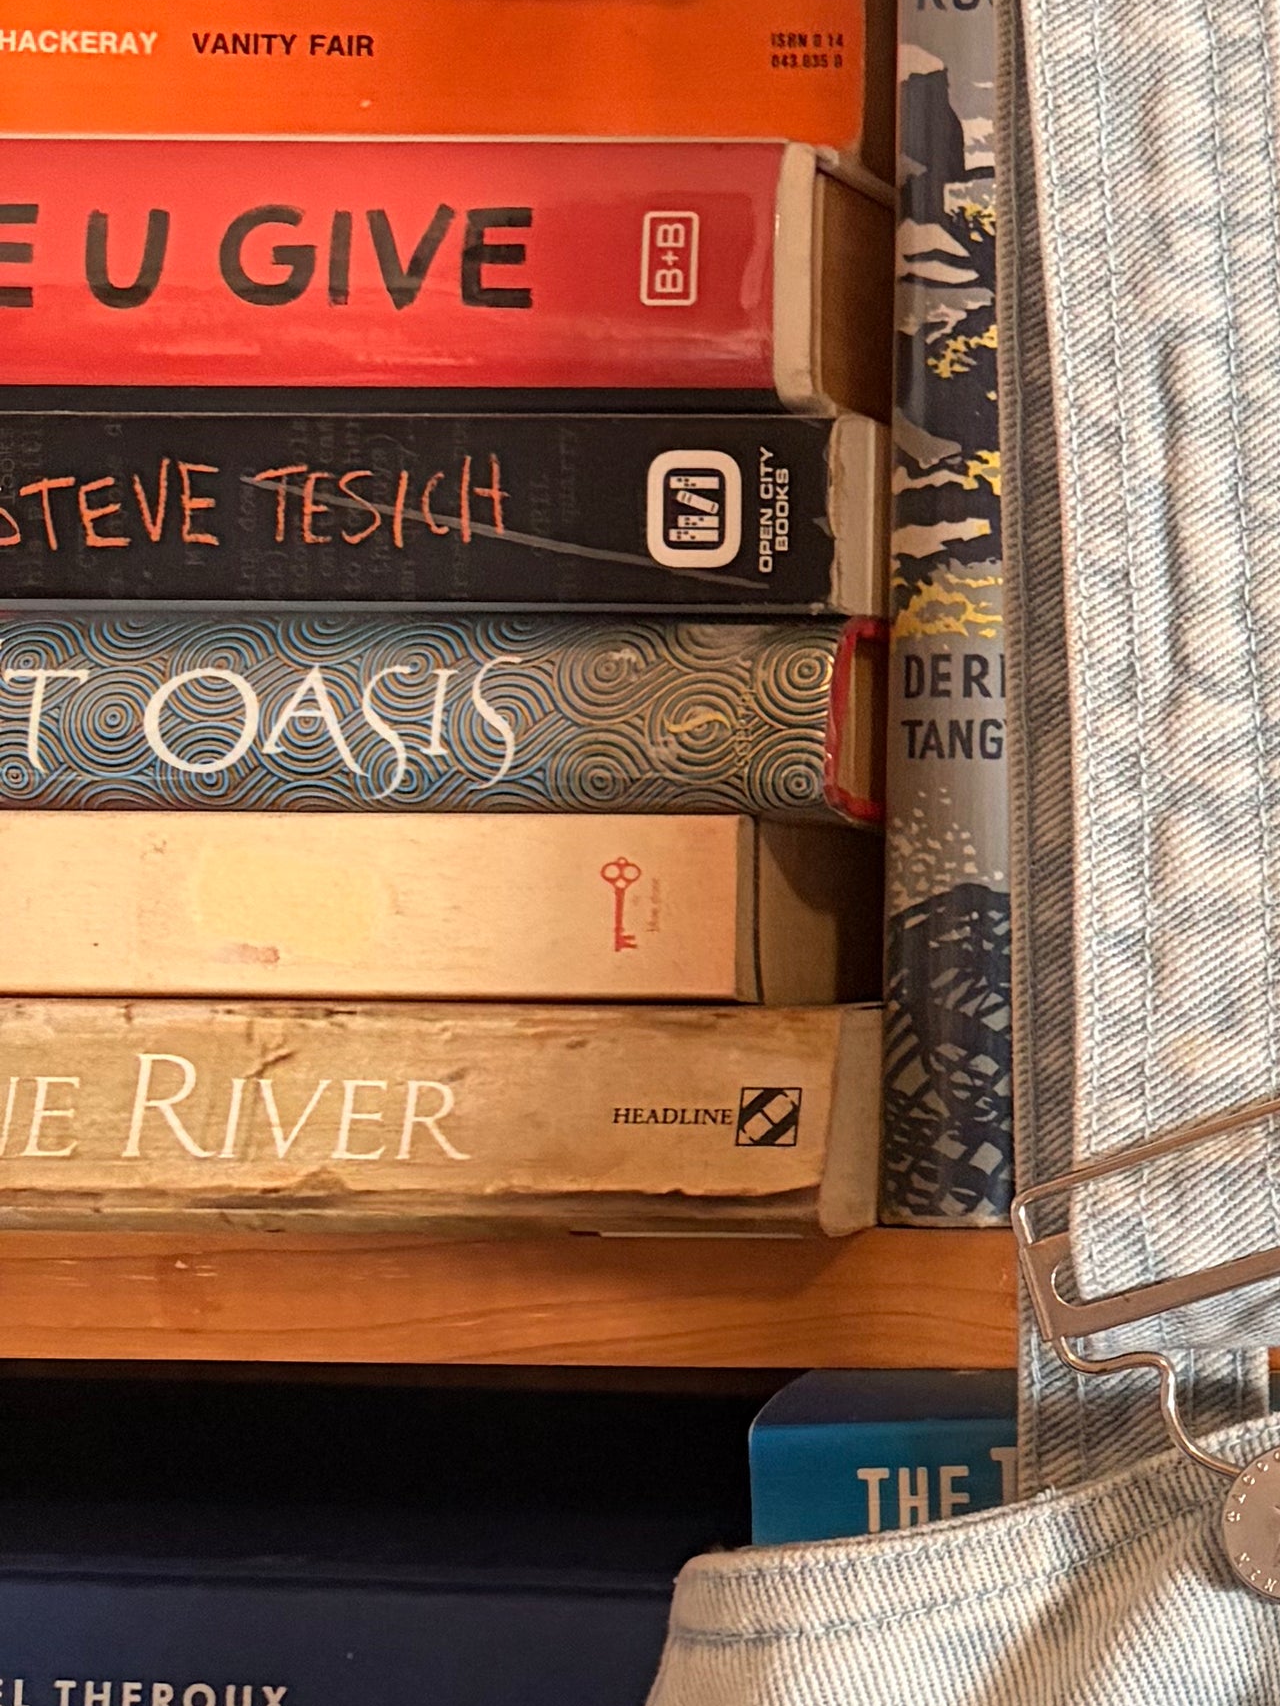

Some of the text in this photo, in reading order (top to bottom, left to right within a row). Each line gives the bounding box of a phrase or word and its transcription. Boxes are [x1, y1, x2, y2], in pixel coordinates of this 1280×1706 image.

[0, 31, 375, 57] HACKERAY VANITY FAIR
[770, 32, 807, 48] ISBN
[85, 203, 534, 311] U GIVE
[654, 220, 687, 294] B+B
[0, 453, 510, 549] STEVE TESICH
[758, 446, 775, 574] OPEN CITY
[775, 467, 791, 553] BOOKS
[143, 655, 523, 800] OASIS
[121, 1053, 472, 1162] RIVER
[612, 1107, 734, 1126] HEADLINE
[856, 1466, 971, 1531] THE
